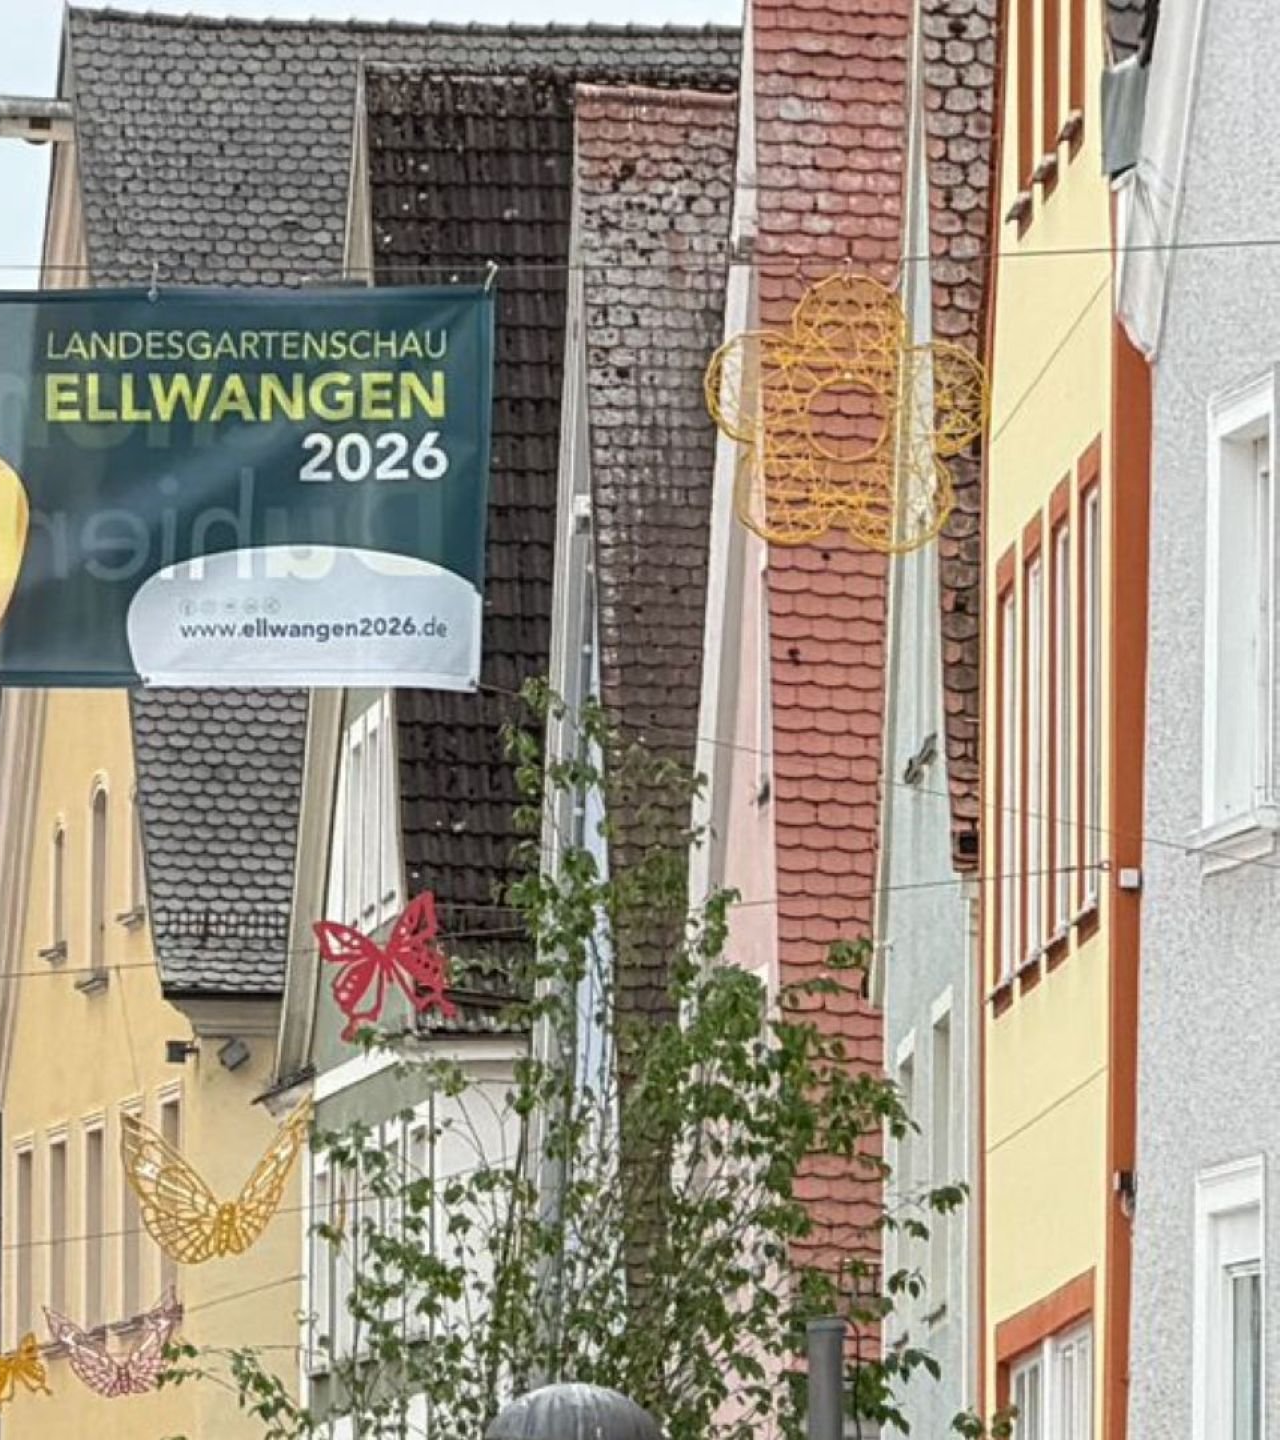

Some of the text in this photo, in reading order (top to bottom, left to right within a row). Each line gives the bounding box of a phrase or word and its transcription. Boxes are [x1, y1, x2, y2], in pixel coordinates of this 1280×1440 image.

[46, 330, 448, 361] LANDESGARTENSCHAU
[44, 371, 446, 423] ELLWANGEN
[298, 431, 449, 482] 2026
[179, 617, 448, 644] www.ellwangen2026.de
